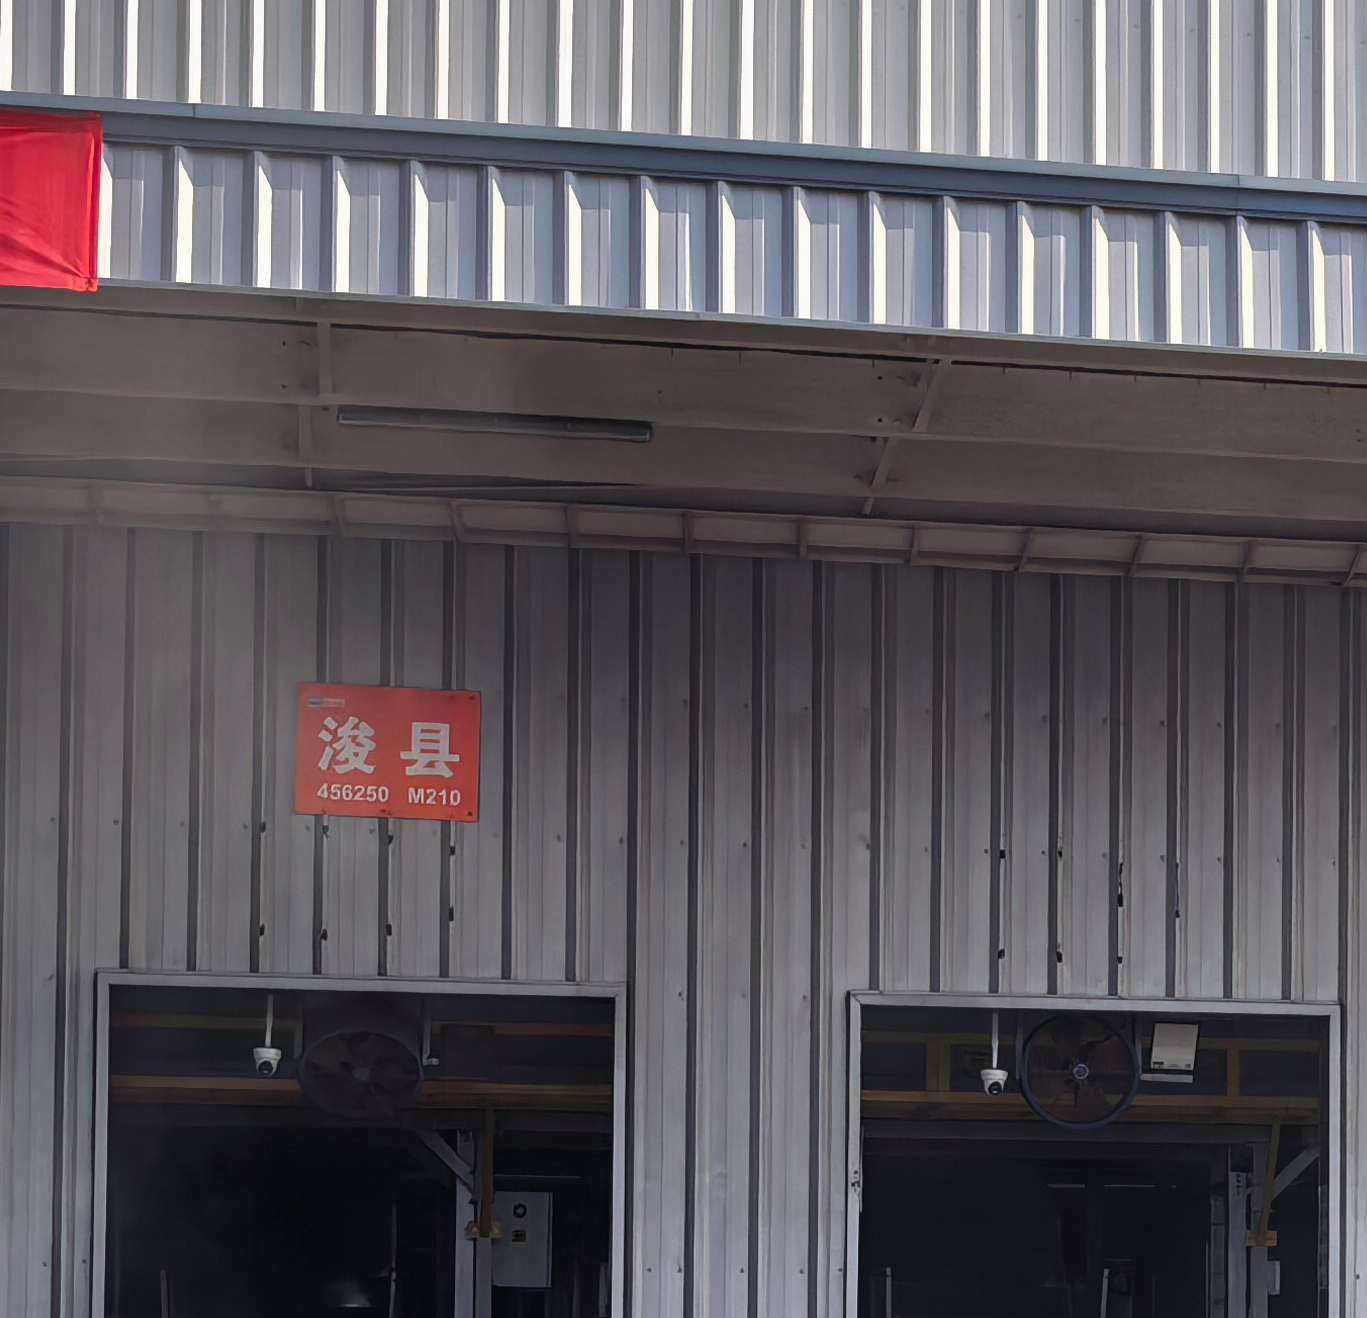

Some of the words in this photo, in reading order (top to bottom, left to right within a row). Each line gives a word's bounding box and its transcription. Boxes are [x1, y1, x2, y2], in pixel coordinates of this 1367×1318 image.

[317, 716, 461, 778] 浚县
[317, 783, 390, 802] 456250
[408, 787, 461, 806] M210
